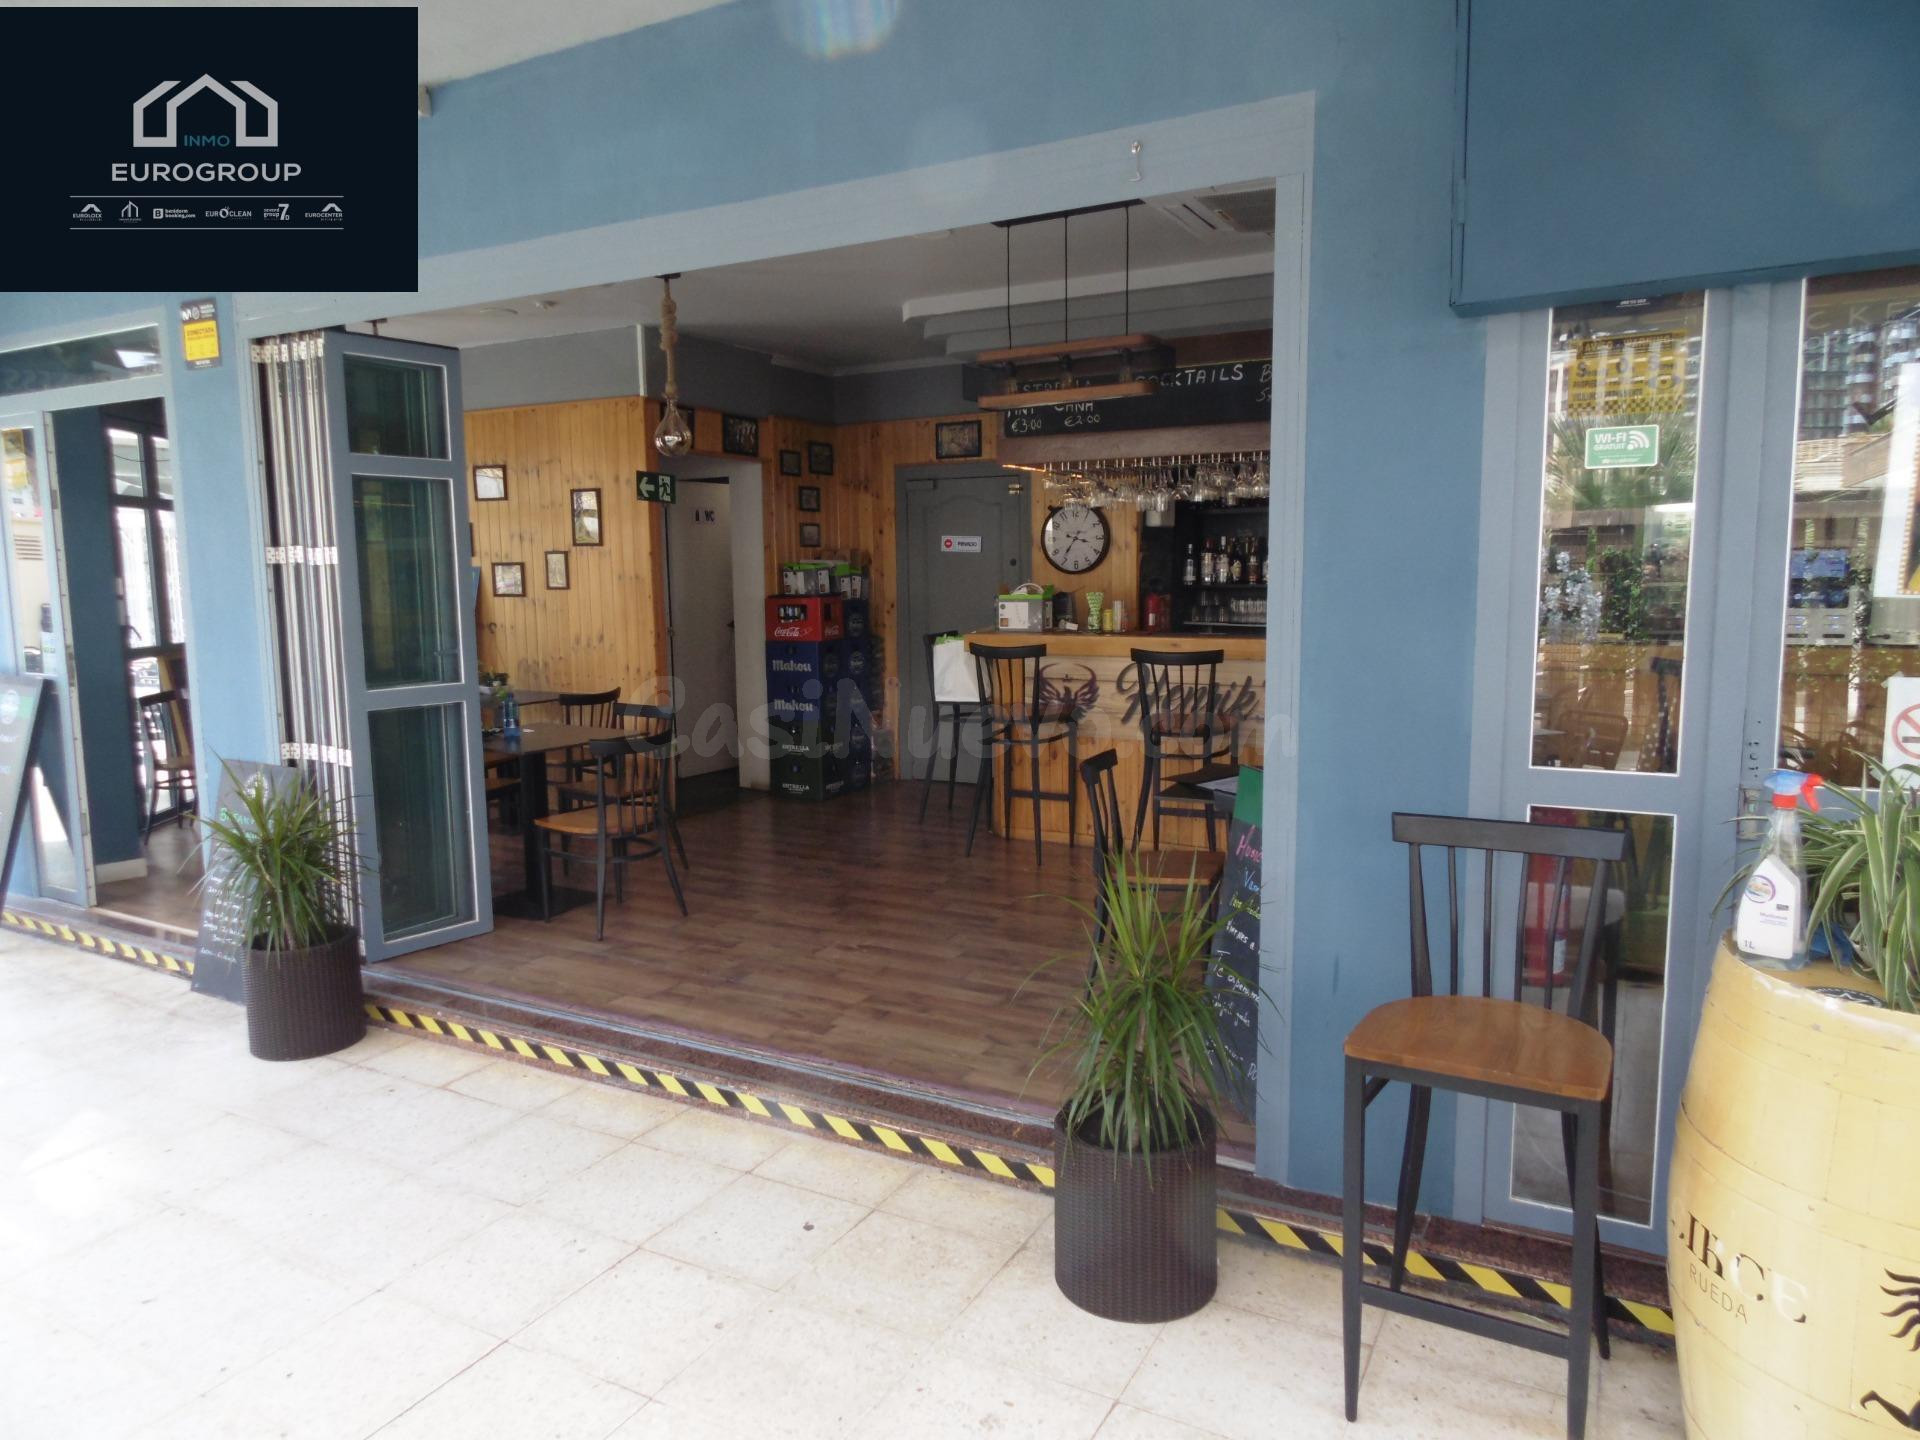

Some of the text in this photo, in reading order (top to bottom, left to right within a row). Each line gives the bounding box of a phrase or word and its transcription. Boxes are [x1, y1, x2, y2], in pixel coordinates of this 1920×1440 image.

[1594, 432, 1627, 444] WI-FI
[772, 659, 812, 672] Mahou
[774, 699, 813, 712] Mahou
[1689, 1263, 1747, 1324] RUEDA
